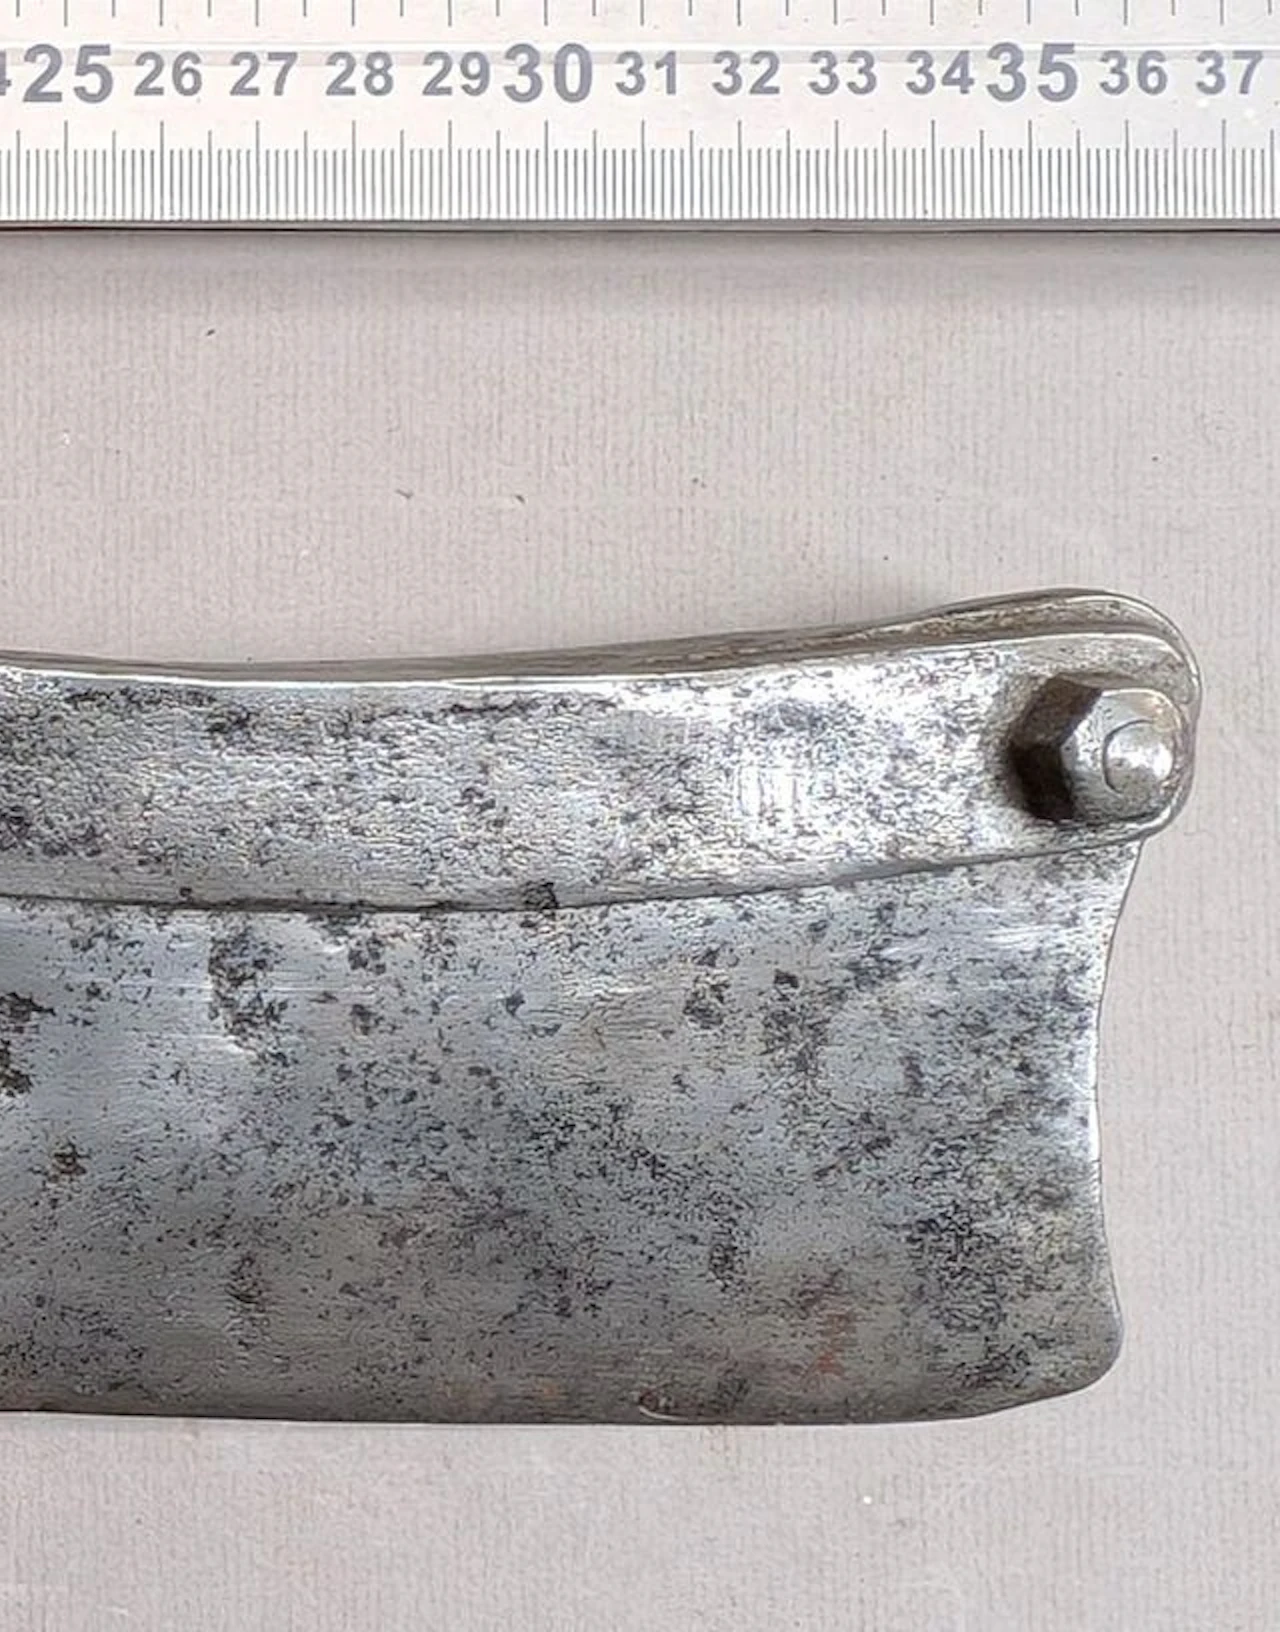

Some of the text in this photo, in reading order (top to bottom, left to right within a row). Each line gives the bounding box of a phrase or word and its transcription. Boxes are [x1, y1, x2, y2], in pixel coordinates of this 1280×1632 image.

[22, 43, 114, 104] 25
[135, 50, 203, 97] 26
[230, 50, 298, 97] 27
[325, 50, 394, 97] 28
[421, 50, 490, 97] 29
[503, 43, 593, 103] 30
[615, 50, 678, 96] 31
[712, 50, 780, 96] 32
[809, 50, 877, 96] 33
[906, 50, 974, 96] 34
[987, 42, 1079, 103] 35
[1099, 50, 1169, 96] 36
[1196, 50, 1264, 96] 37
